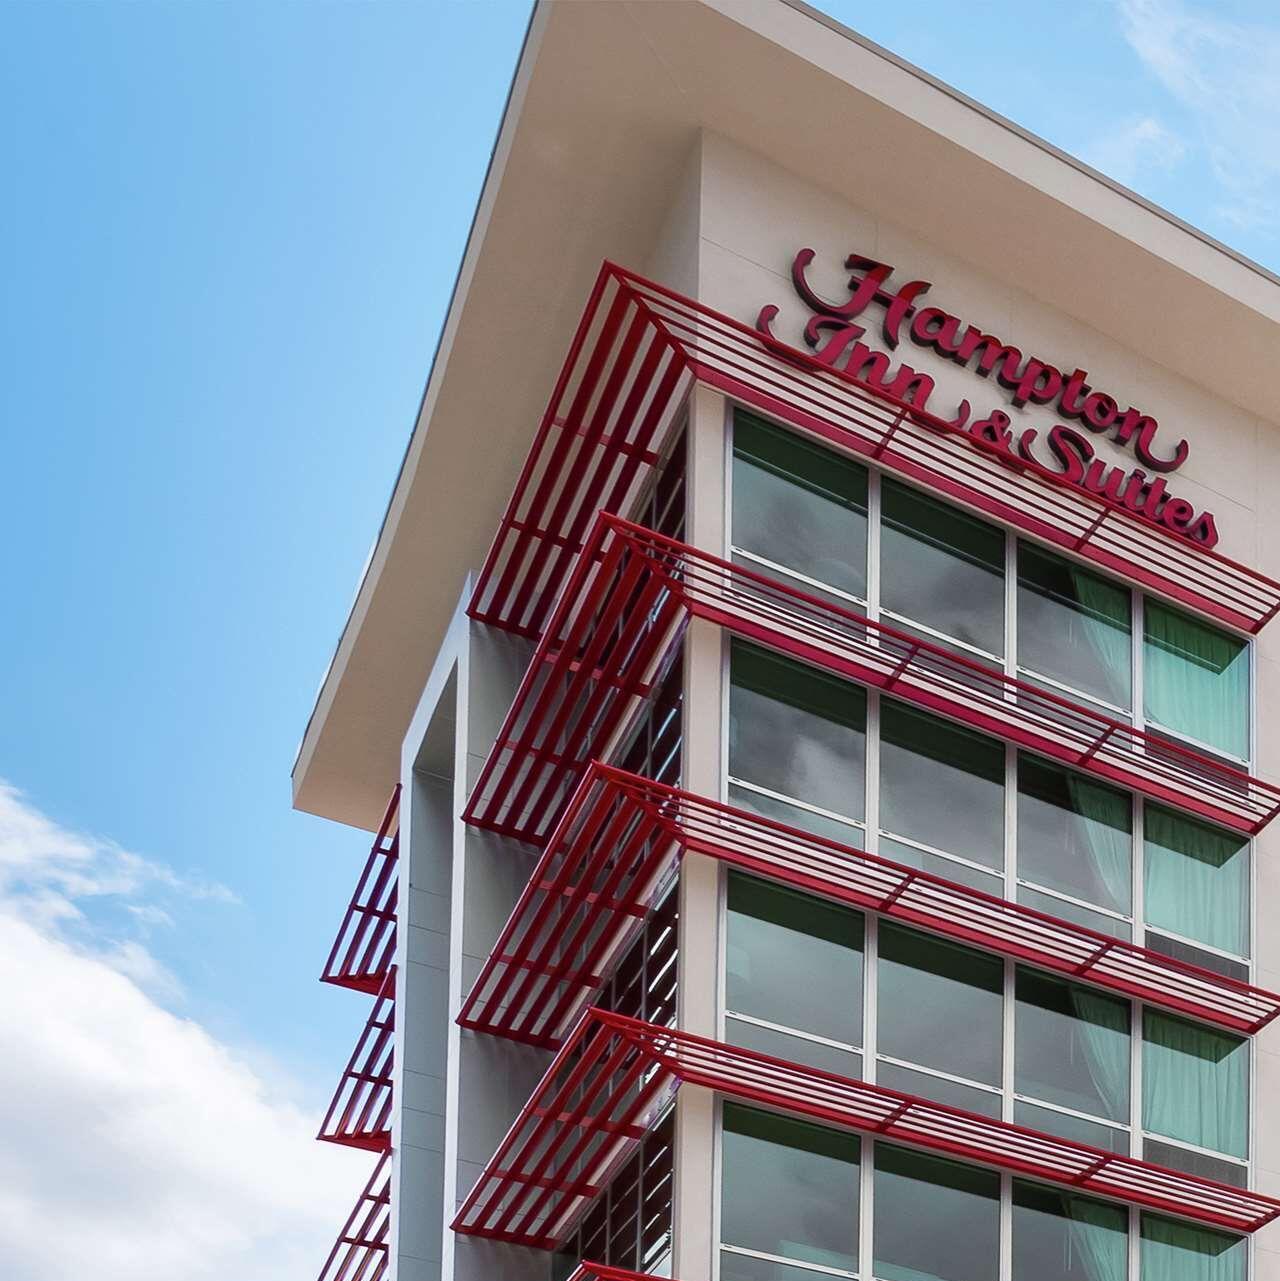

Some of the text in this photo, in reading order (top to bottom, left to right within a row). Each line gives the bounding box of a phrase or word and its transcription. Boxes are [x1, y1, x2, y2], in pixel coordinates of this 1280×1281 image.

[756, 304, 1219, 549] Inn & Suites
[792, 247, 1189, 473] Hampton
